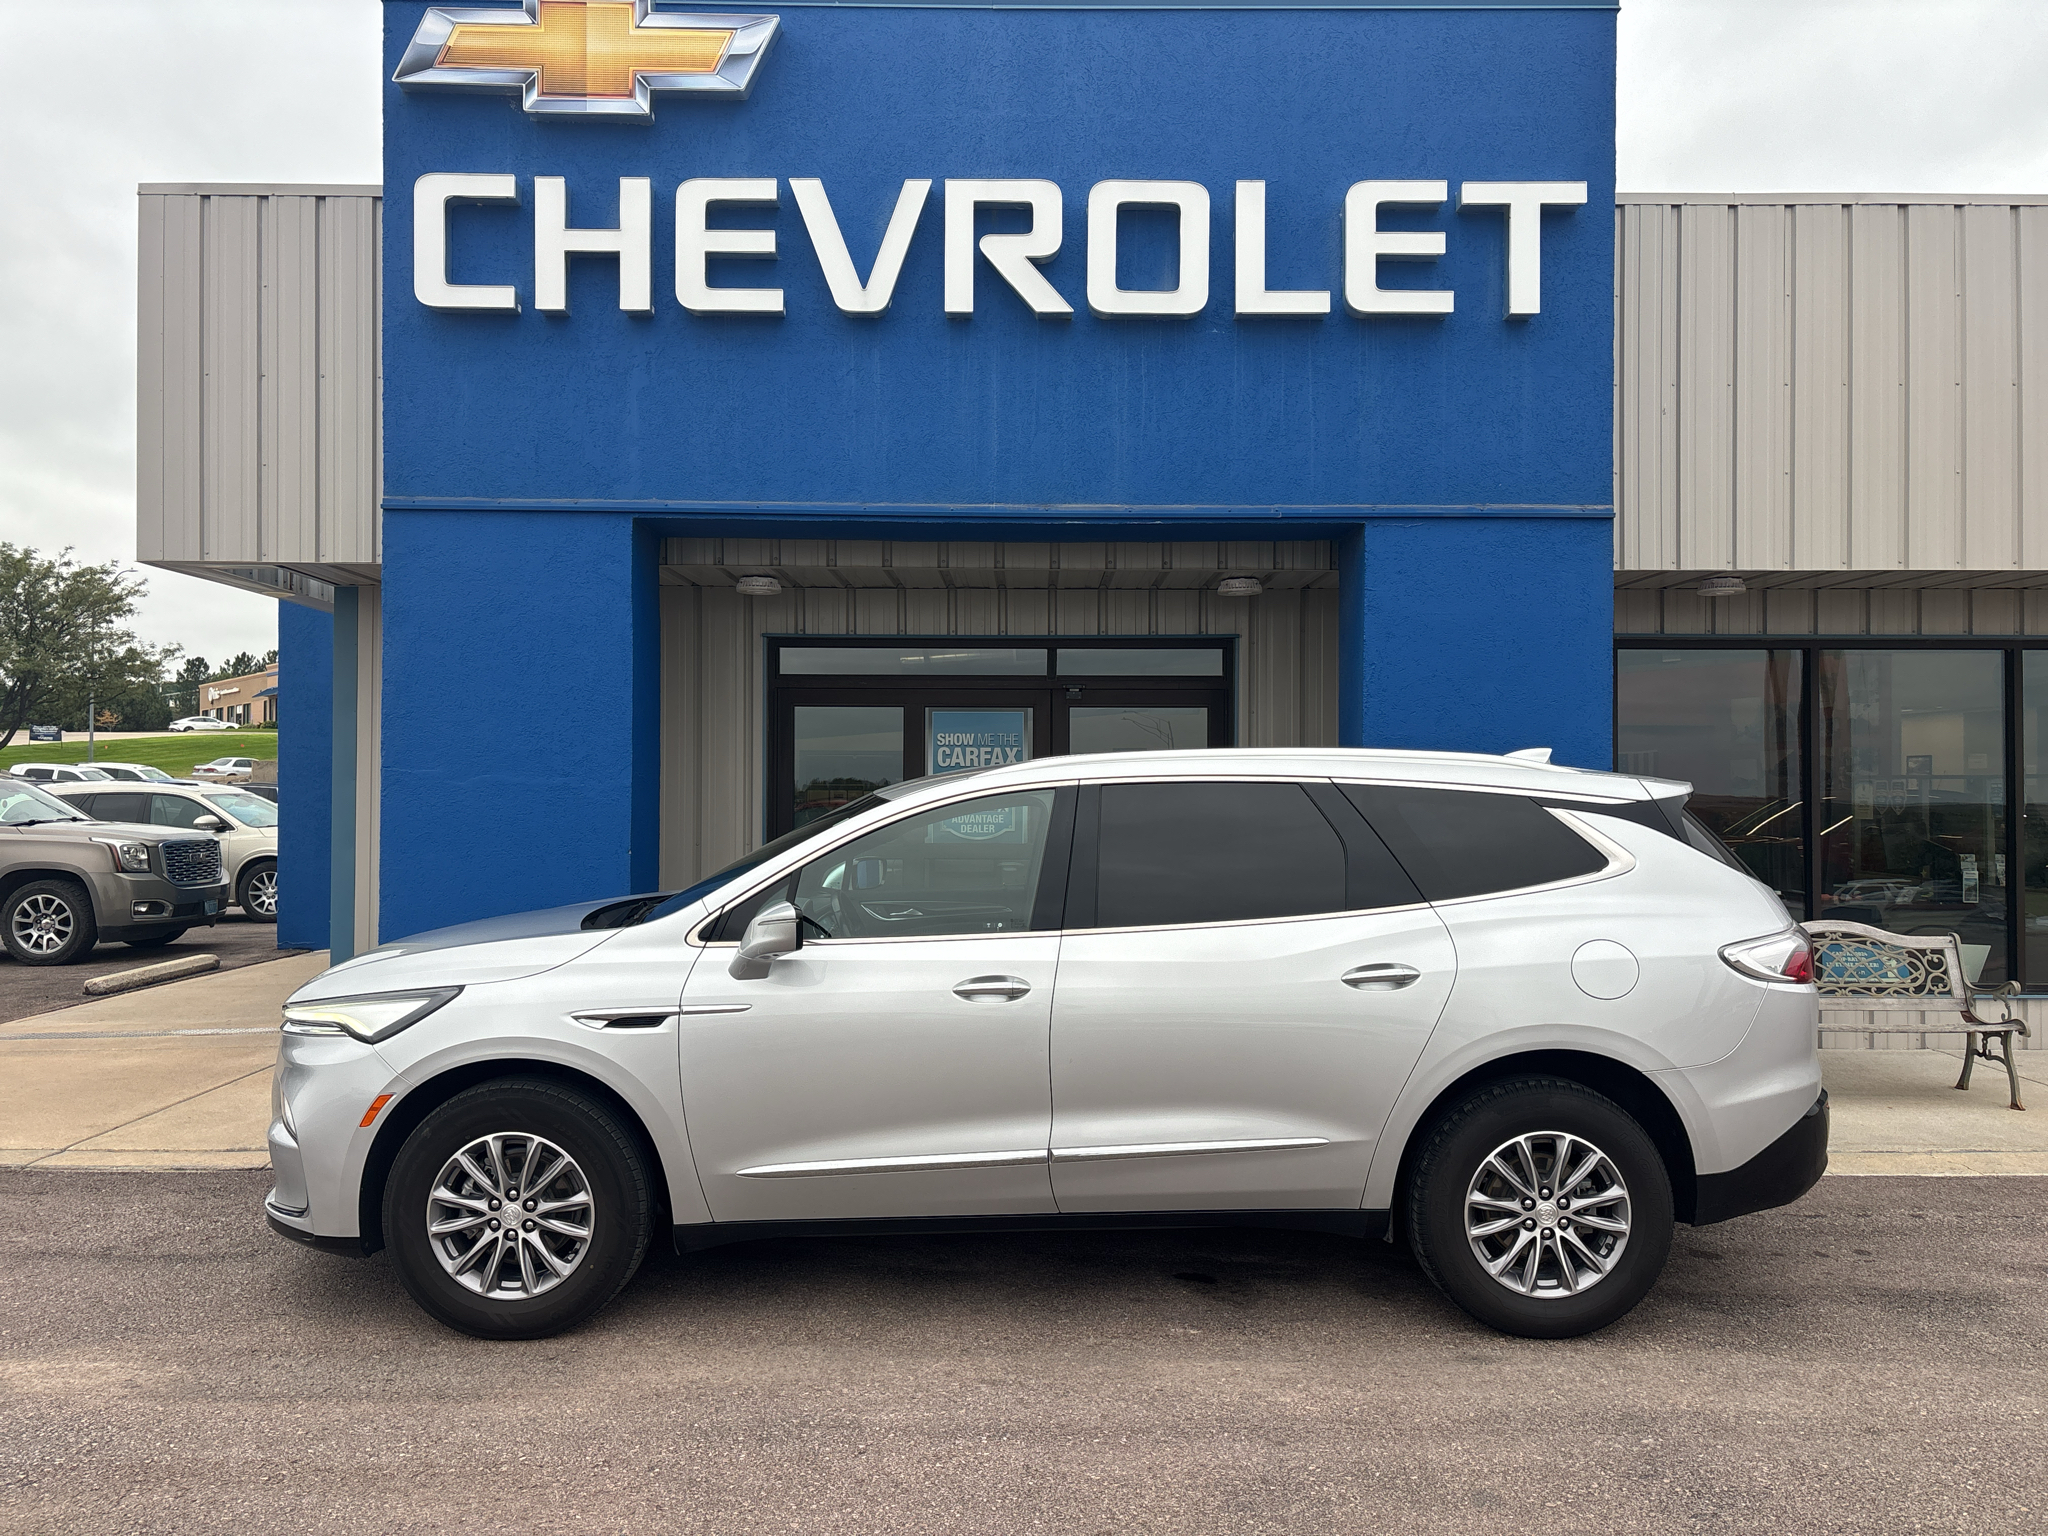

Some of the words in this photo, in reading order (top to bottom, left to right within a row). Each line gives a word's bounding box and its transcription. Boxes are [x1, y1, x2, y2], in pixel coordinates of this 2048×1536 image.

[412, 172, 1589, 319] CHEVROLET
[936, 733, 975, 746] SHOW
[977, 733, 995, 746] ME
[997, 733, 1019, 746] THE
[937, 747, 1019, 767] CARFAX
[952, 814, 1004, 823] ADVANTAGE
[960, 824, 995, 833] DEALER
